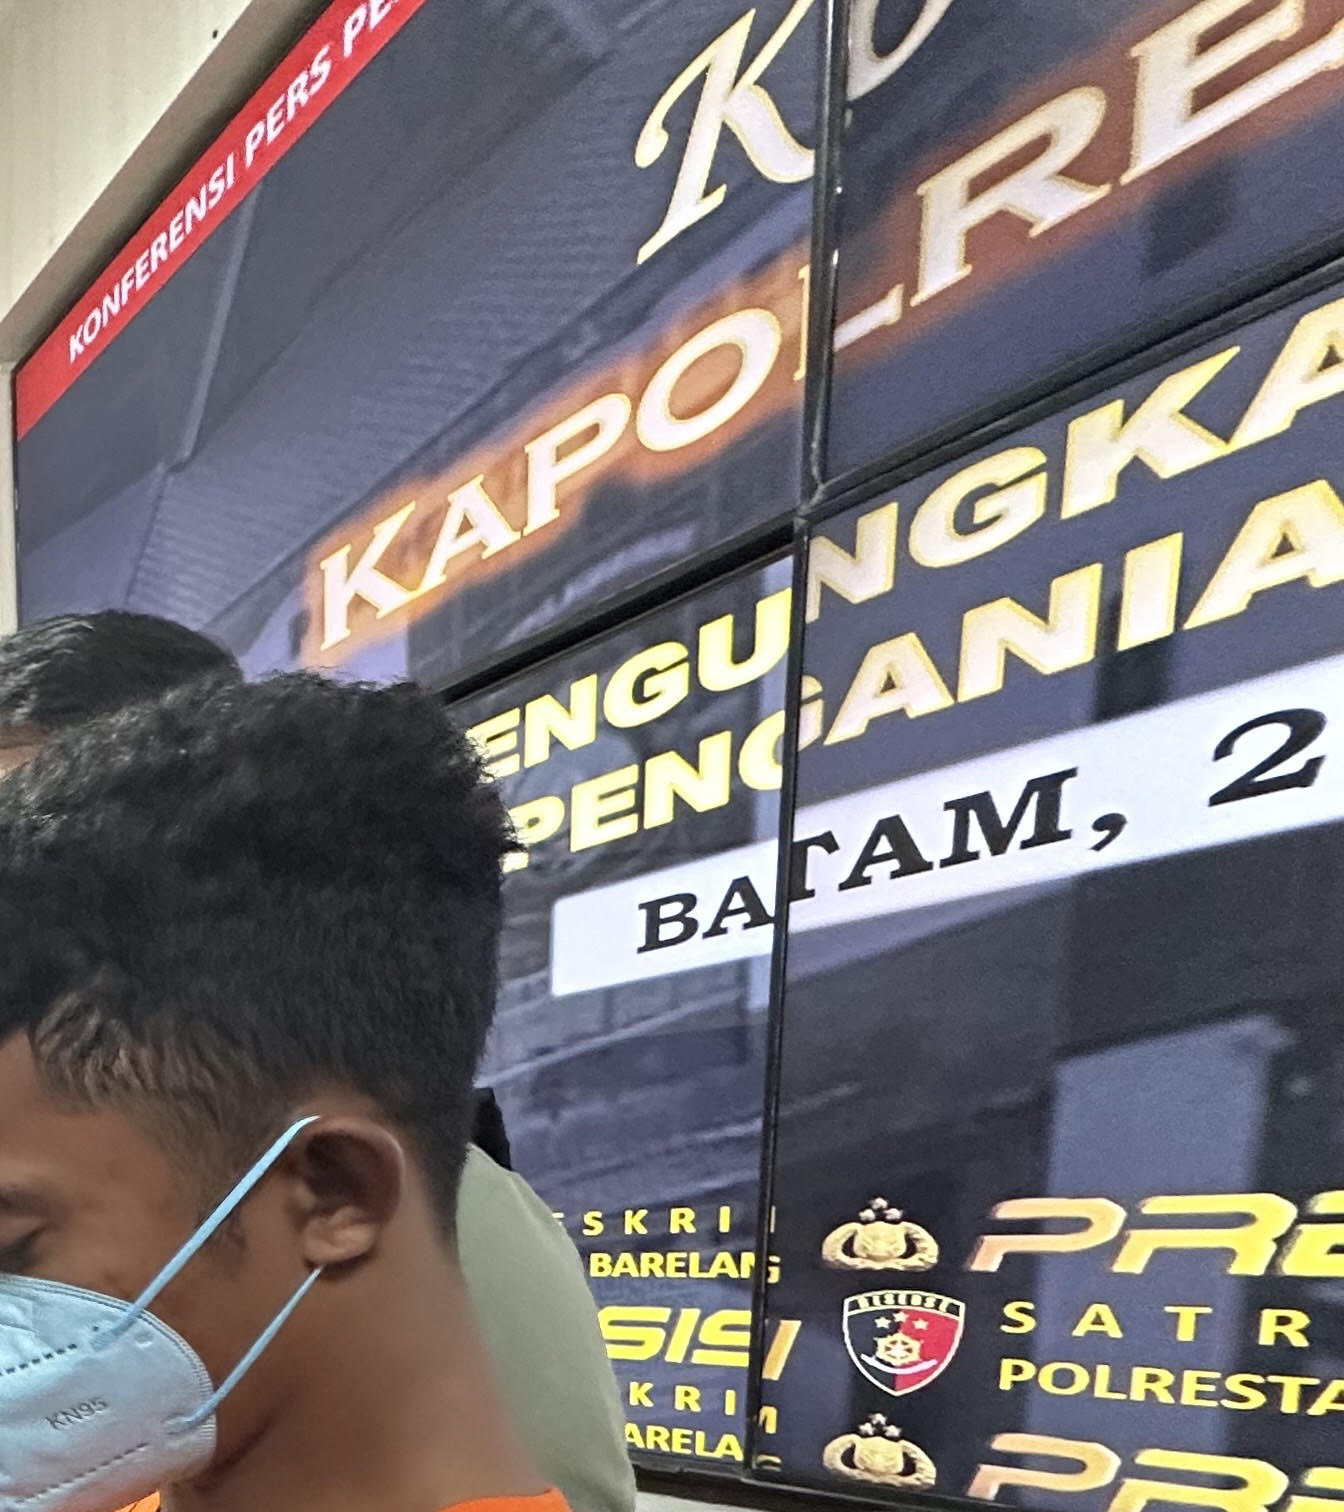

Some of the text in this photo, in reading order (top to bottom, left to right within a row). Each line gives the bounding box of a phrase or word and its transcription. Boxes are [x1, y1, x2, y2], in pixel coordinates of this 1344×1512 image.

[69, 152, 234, 364] KONFERENSI
[245, 44, 332, 168] PERS
[637, 708, 1328, 954] BATAM, 2
[552, 1205, 775, 1236] SKRI
[45, 1396, 109, 1431] KN95
